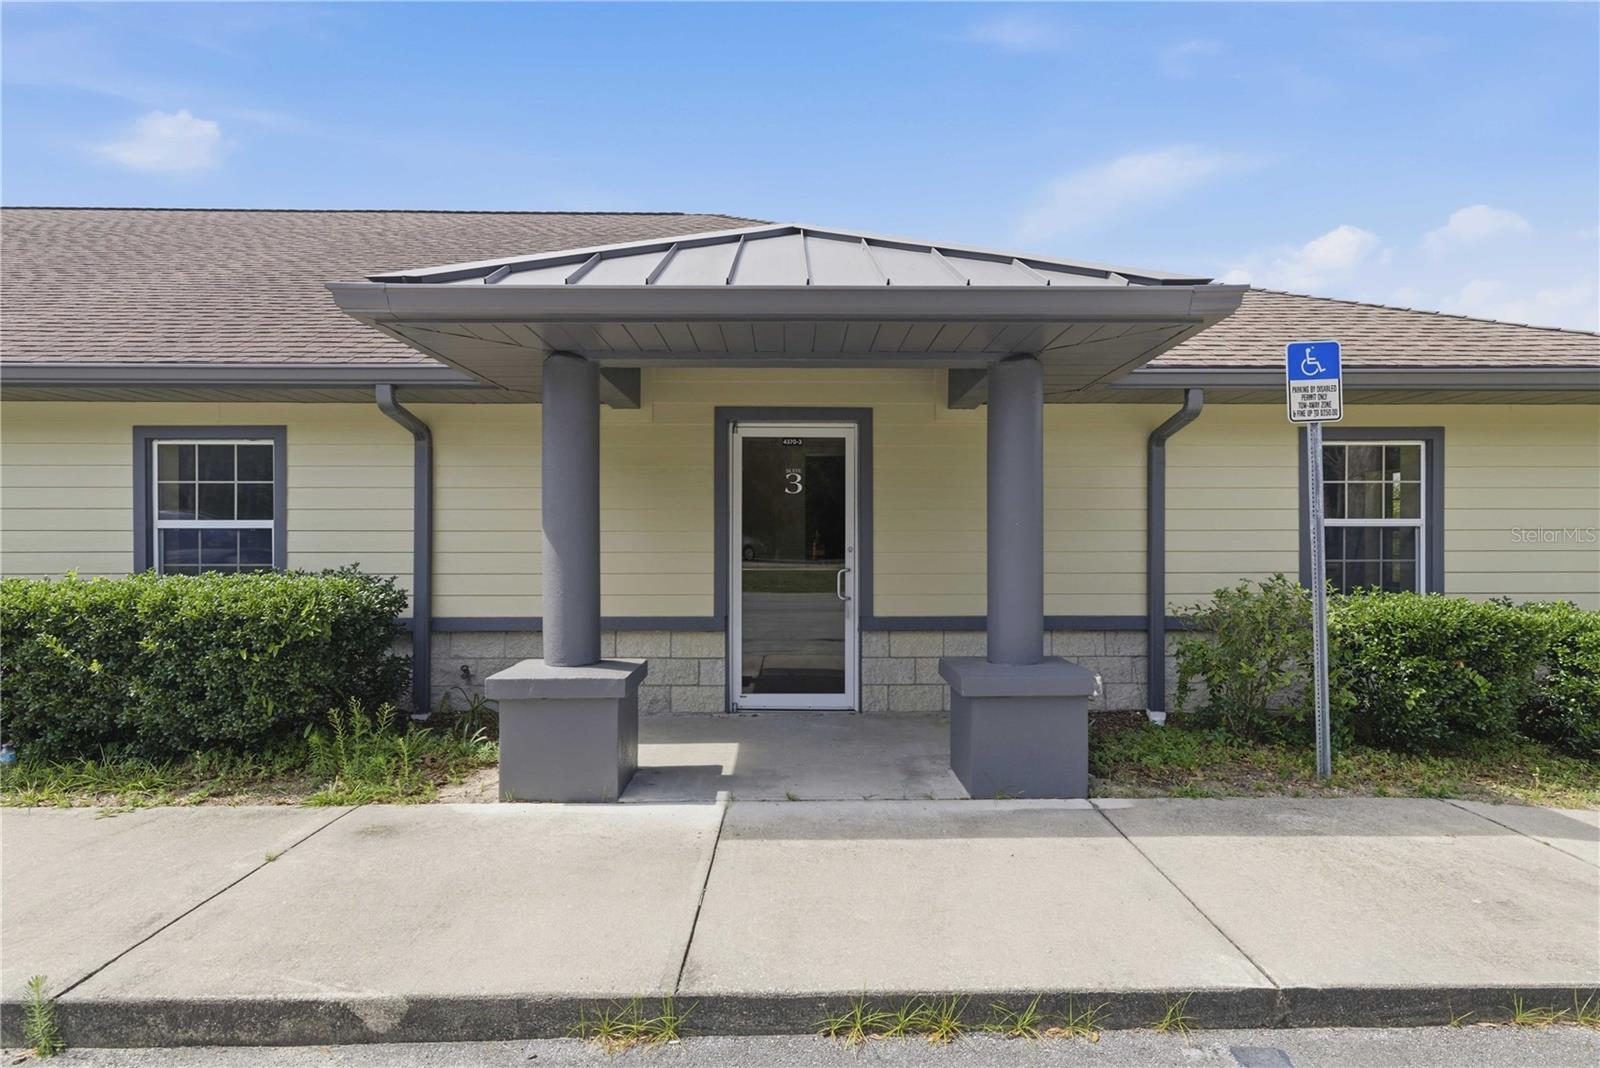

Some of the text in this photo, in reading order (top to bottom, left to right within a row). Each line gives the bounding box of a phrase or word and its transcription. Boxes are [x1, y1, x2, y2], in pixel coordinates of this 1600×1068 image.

[1292, 384, 1337, 393] PARKING BY DISABLED
[784, 472, 802, 494] 3
